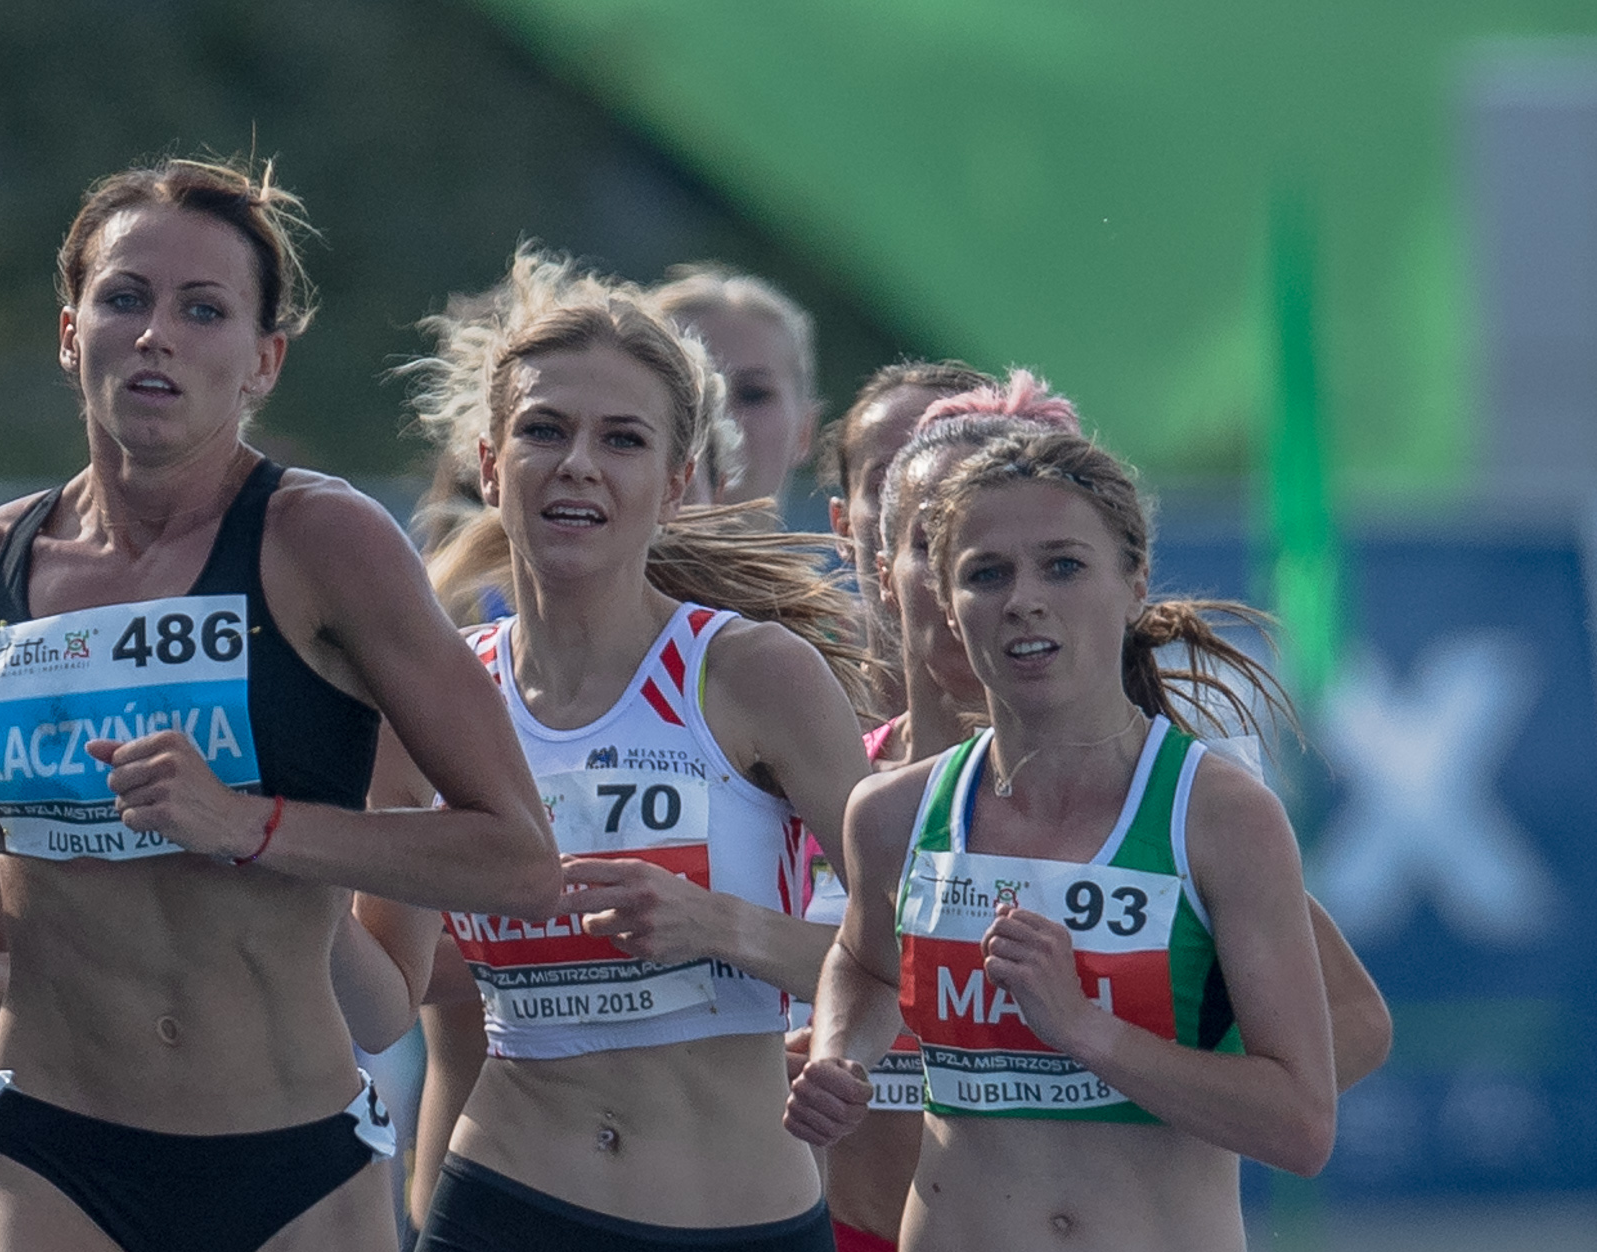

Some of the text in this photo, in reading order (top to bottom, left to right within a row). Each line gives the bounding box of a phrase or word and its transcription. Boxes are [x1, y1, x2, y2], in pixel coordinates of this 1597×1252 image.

[111, 610, 244, 668] 486
[627, 748, 689, 761] MIASTO
[596, 783, 682, 833] 70
[48, 829, 179, 854] LUBLIN 20
[1063, 880, 1149, 937] 93
[530, 964, 641, 983] MISTRZOSTWA
[512, 990, 655, 1019] LUBLIN 2018
[936, 1051, 973, 1068] PZLA
[974, 1055, 1084, 1072] MISTRZOST
[875, 1084, 924, 1105] LUB
[957, 1080, 1110, 1103] LUBLIN 2018
